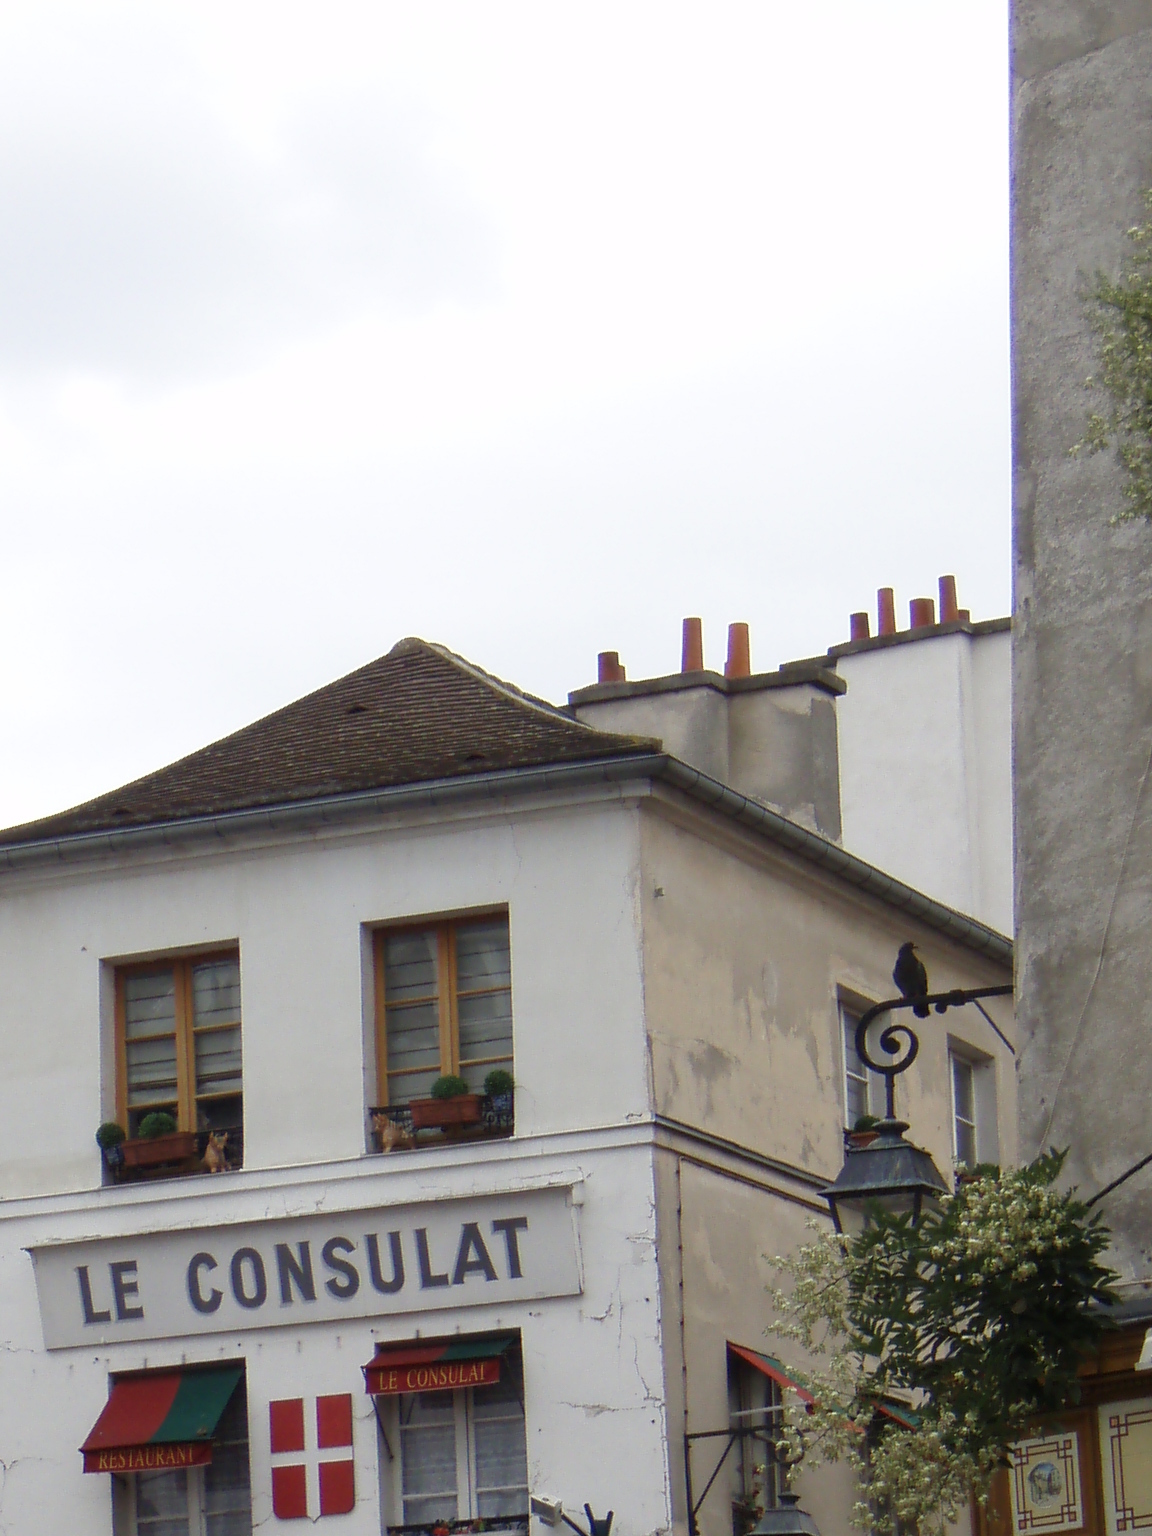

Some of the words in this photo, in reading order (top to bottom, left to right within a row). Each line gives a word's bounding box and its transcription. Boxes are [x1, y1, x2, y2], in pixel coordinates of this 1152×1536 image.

[76, 1259, 145, 1325] LE
[186, 1216, 528, 1315] CONSULAT
[379, 1370, 398, 1391] LE
[406, 1361, 488, 1389] CONSULAT
[98, 1443, 195, 1470] RESTAURANT
